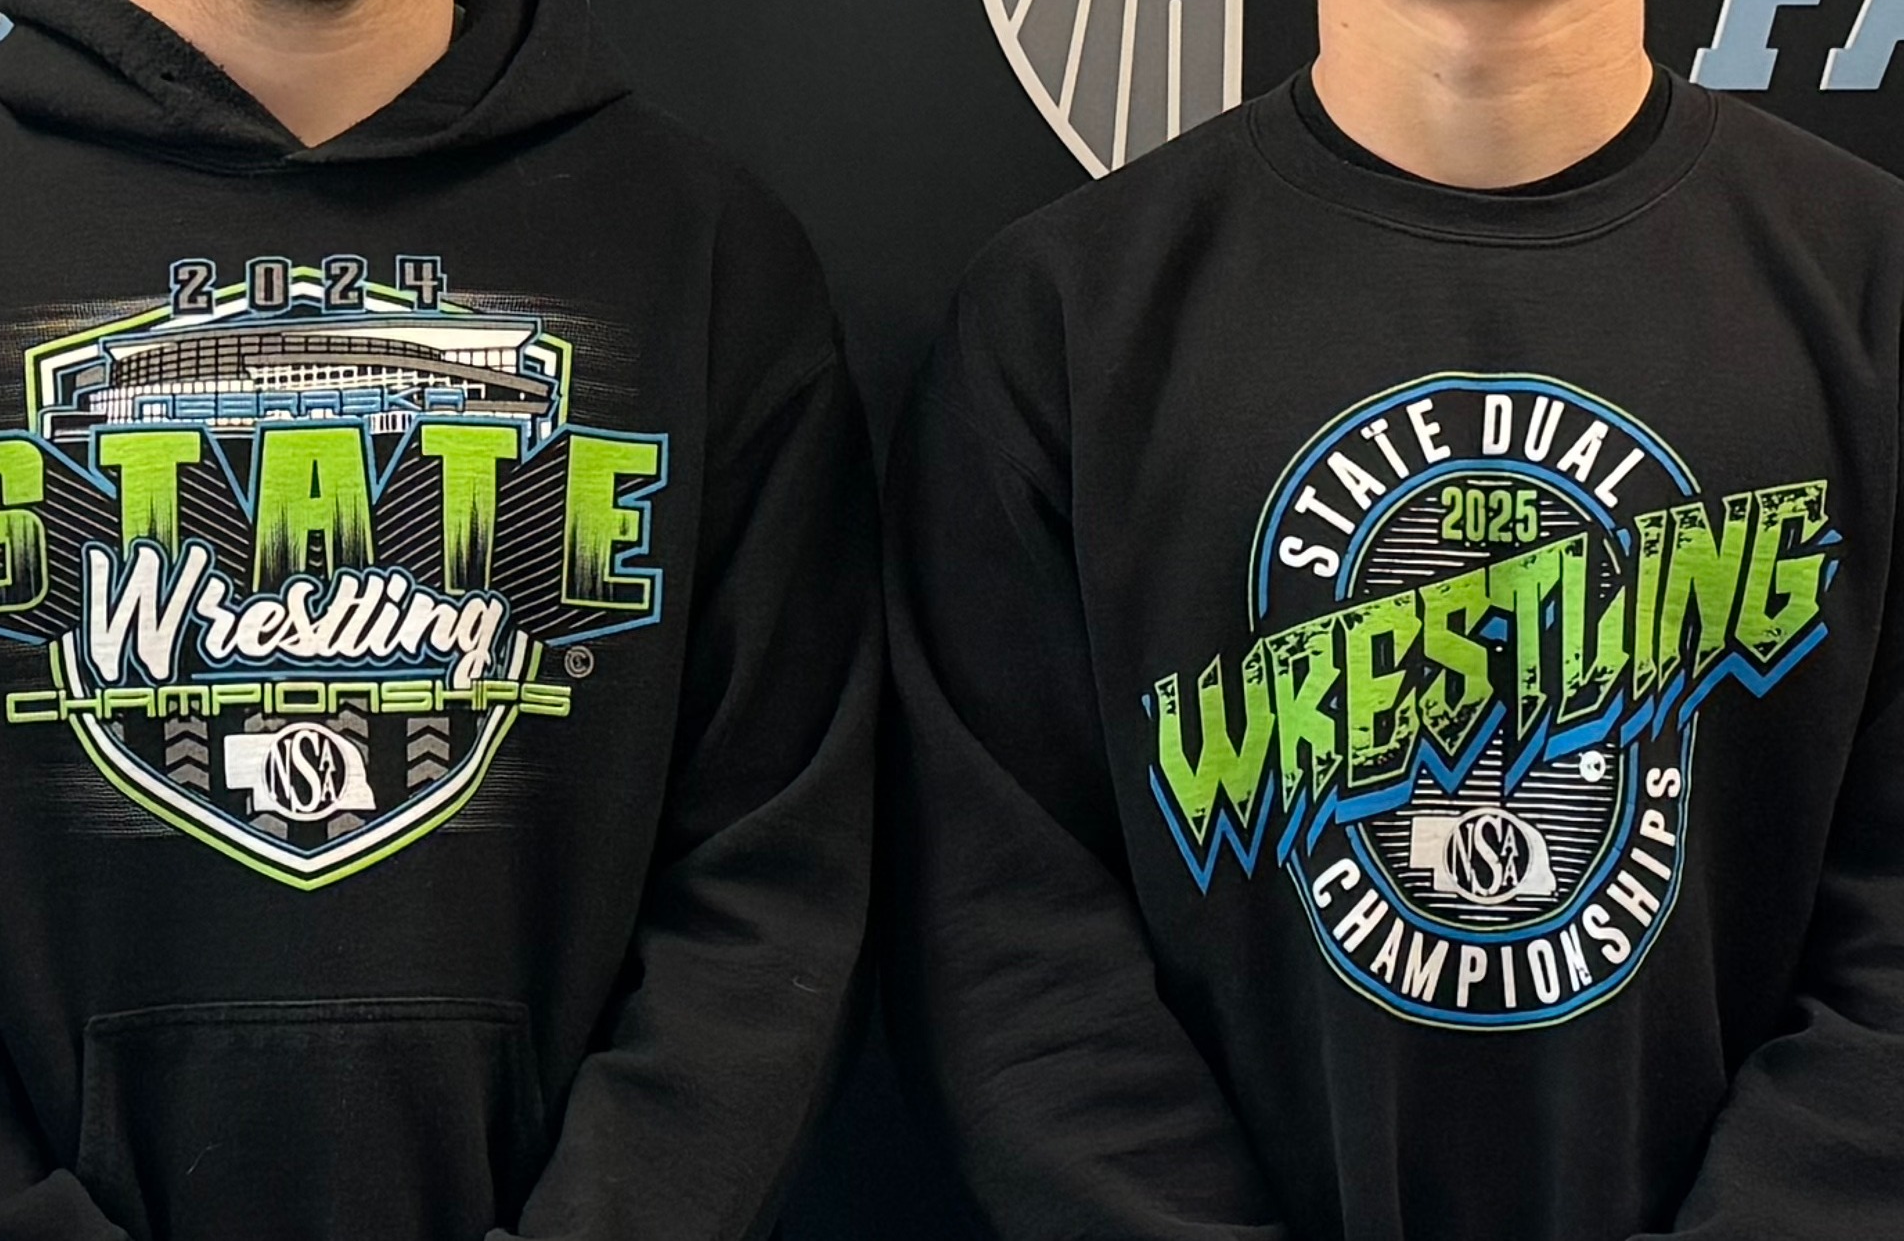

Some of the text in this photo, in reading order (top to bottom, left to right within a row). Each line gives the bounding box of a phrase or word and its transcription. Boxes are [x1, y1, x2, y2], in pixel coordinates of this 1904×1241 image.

[169, 255, 446, 314] 2024
[1278, 393, 1646, 579] STATE DUAL
[1440, 485, 1540, 544] 2025
[86, 544, 504, 690] Wrestling
[1152, 478, 1830, 848] WRESTLING
[1310, 765, 1682, 1009] CHAMPIONSHIPS
